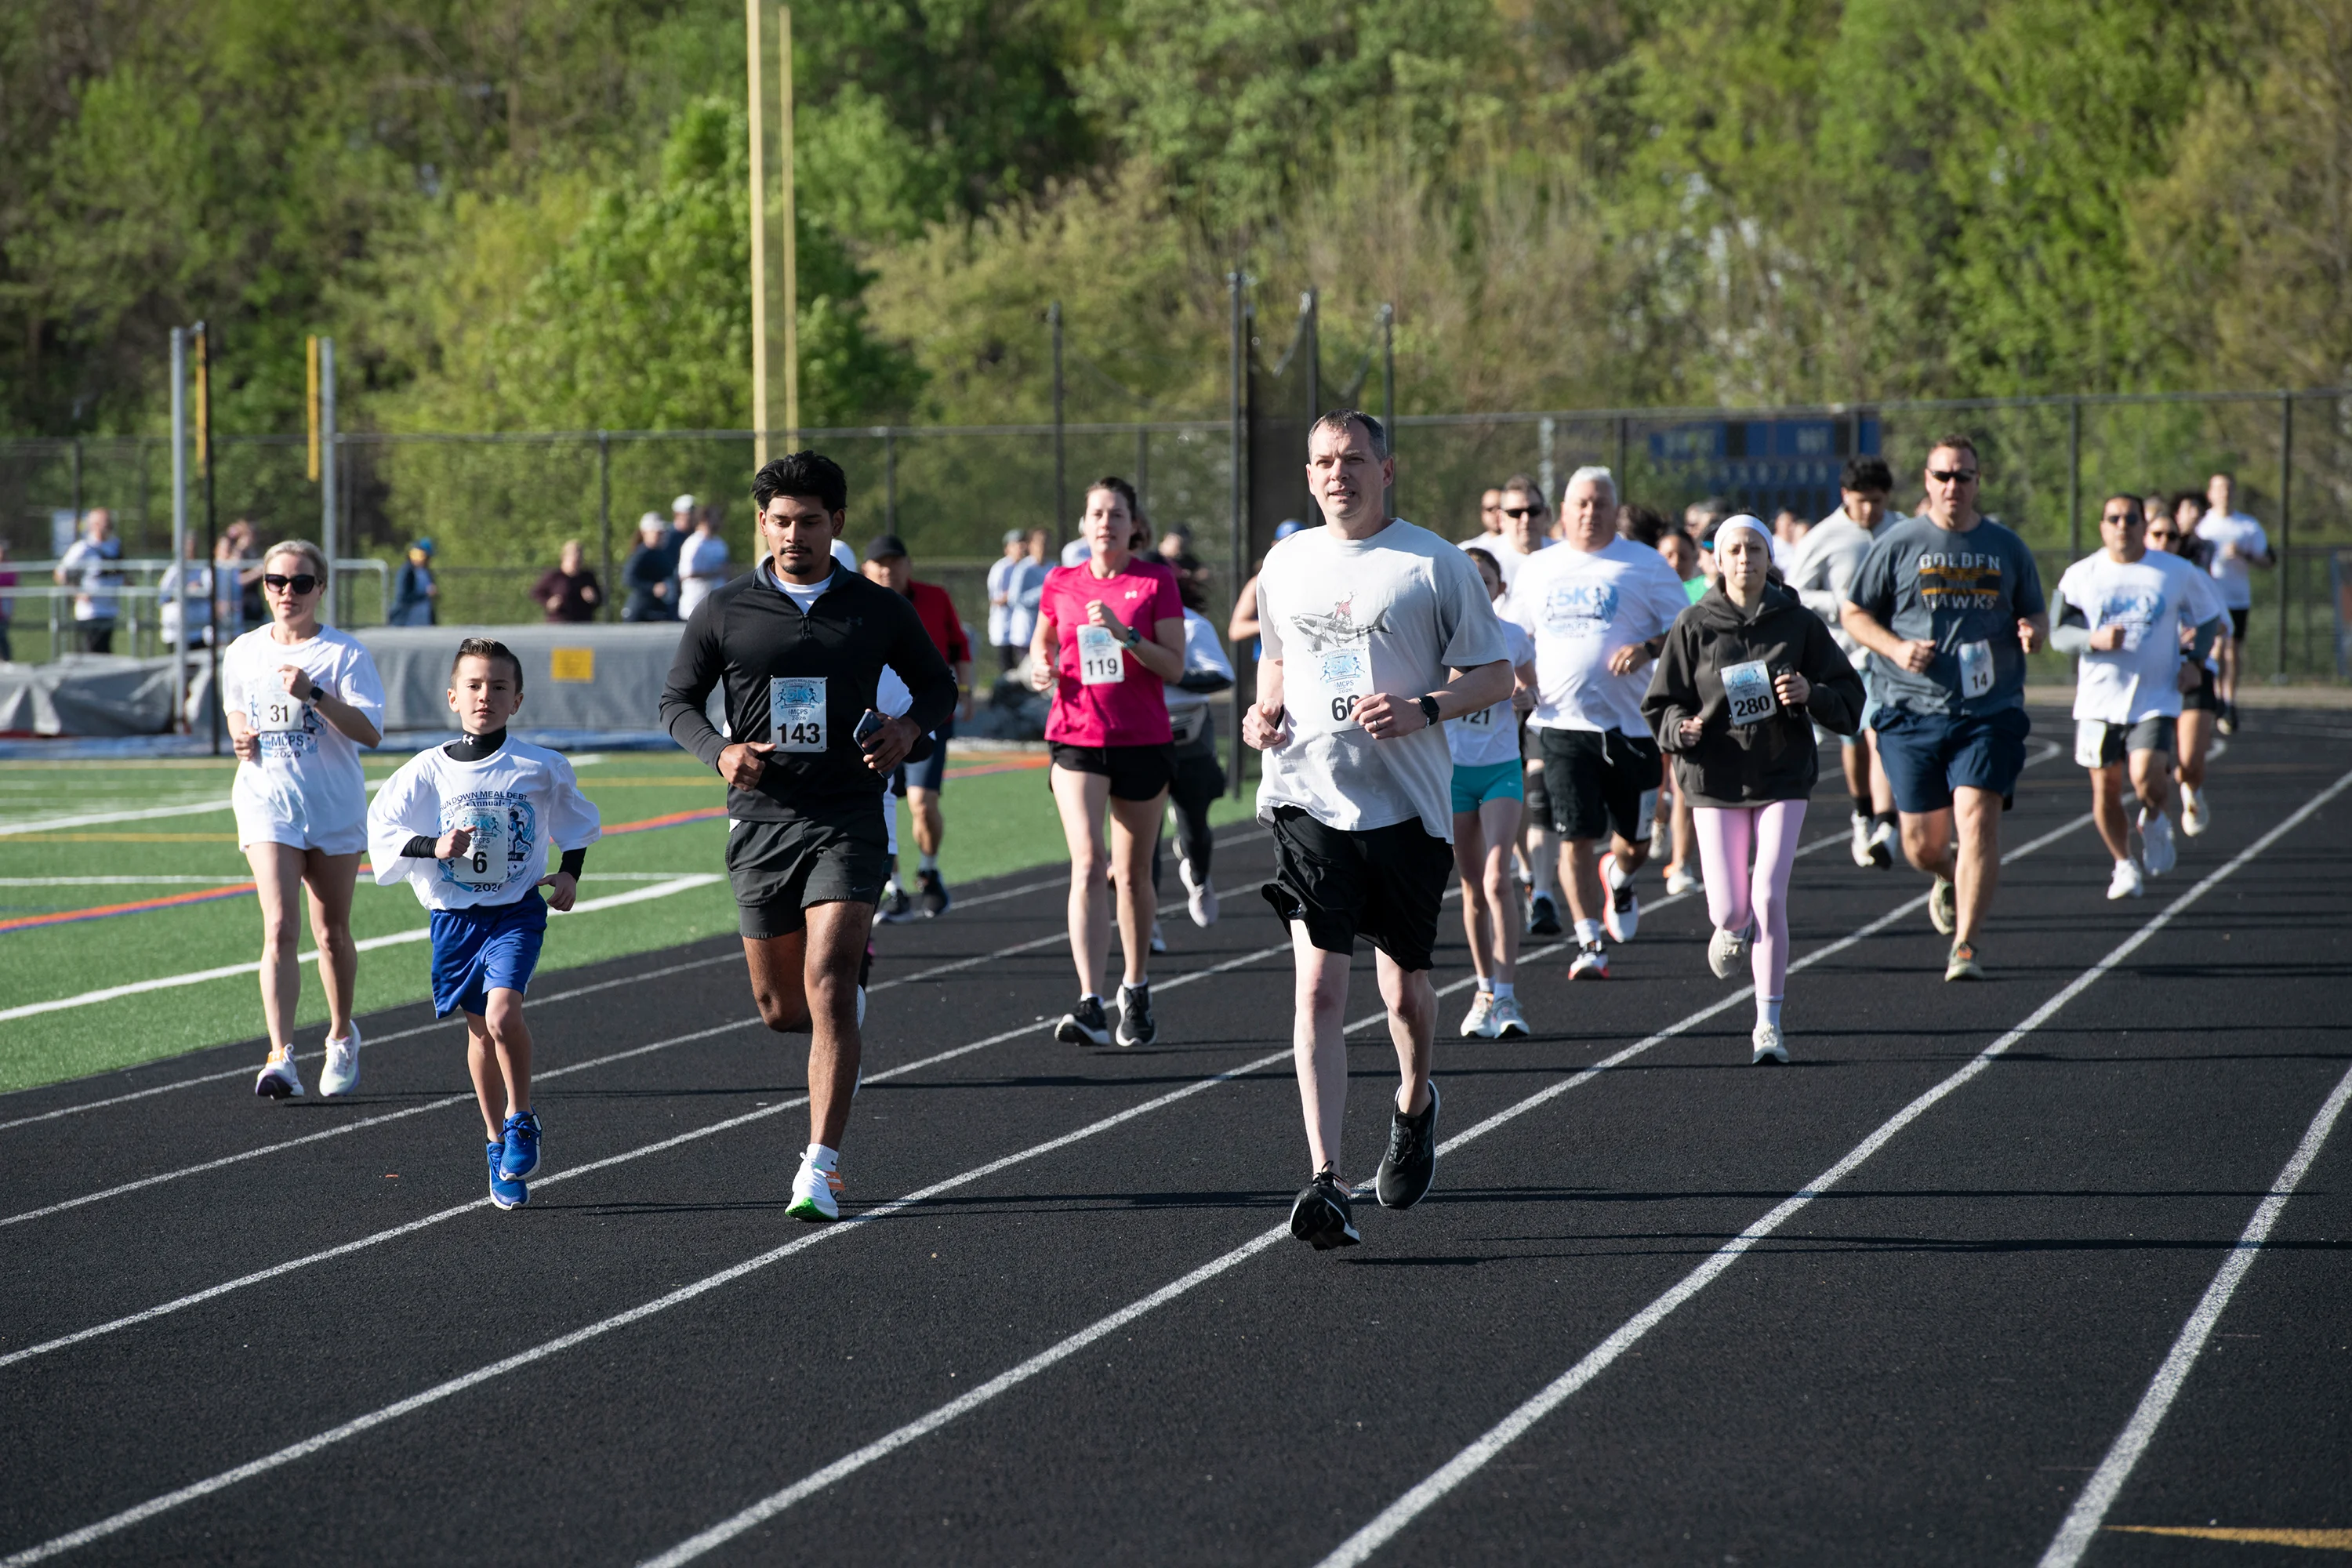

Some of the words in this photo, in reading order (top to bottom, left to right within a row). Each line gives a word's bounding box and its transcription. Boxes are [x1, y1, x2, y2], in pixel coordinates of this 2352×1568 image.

[1919, 552, 2001, 570] GOLDEN
[1555, 586, 1591, 606] 5K
[1085, 658, 1117, 676] 119
[1336, 680, 1354, 688] MCPS
[1972, 673, 1987, 690] 14
[786, 687, 809, 701] 5K
[270, 704, 289, 723] 31
[1734, 695, 1770, 717] 280
[270, 735, 304, 746] MCPS
[777, 723, 820, 744] 143
[274, 750, 301, 758] 2026
[451, 791, 478, 804] DOWN
[480, 790, 505, 799] MEAL
[506, 791, 528, 801] DEBT
[472, 851, 488, 874] 6
